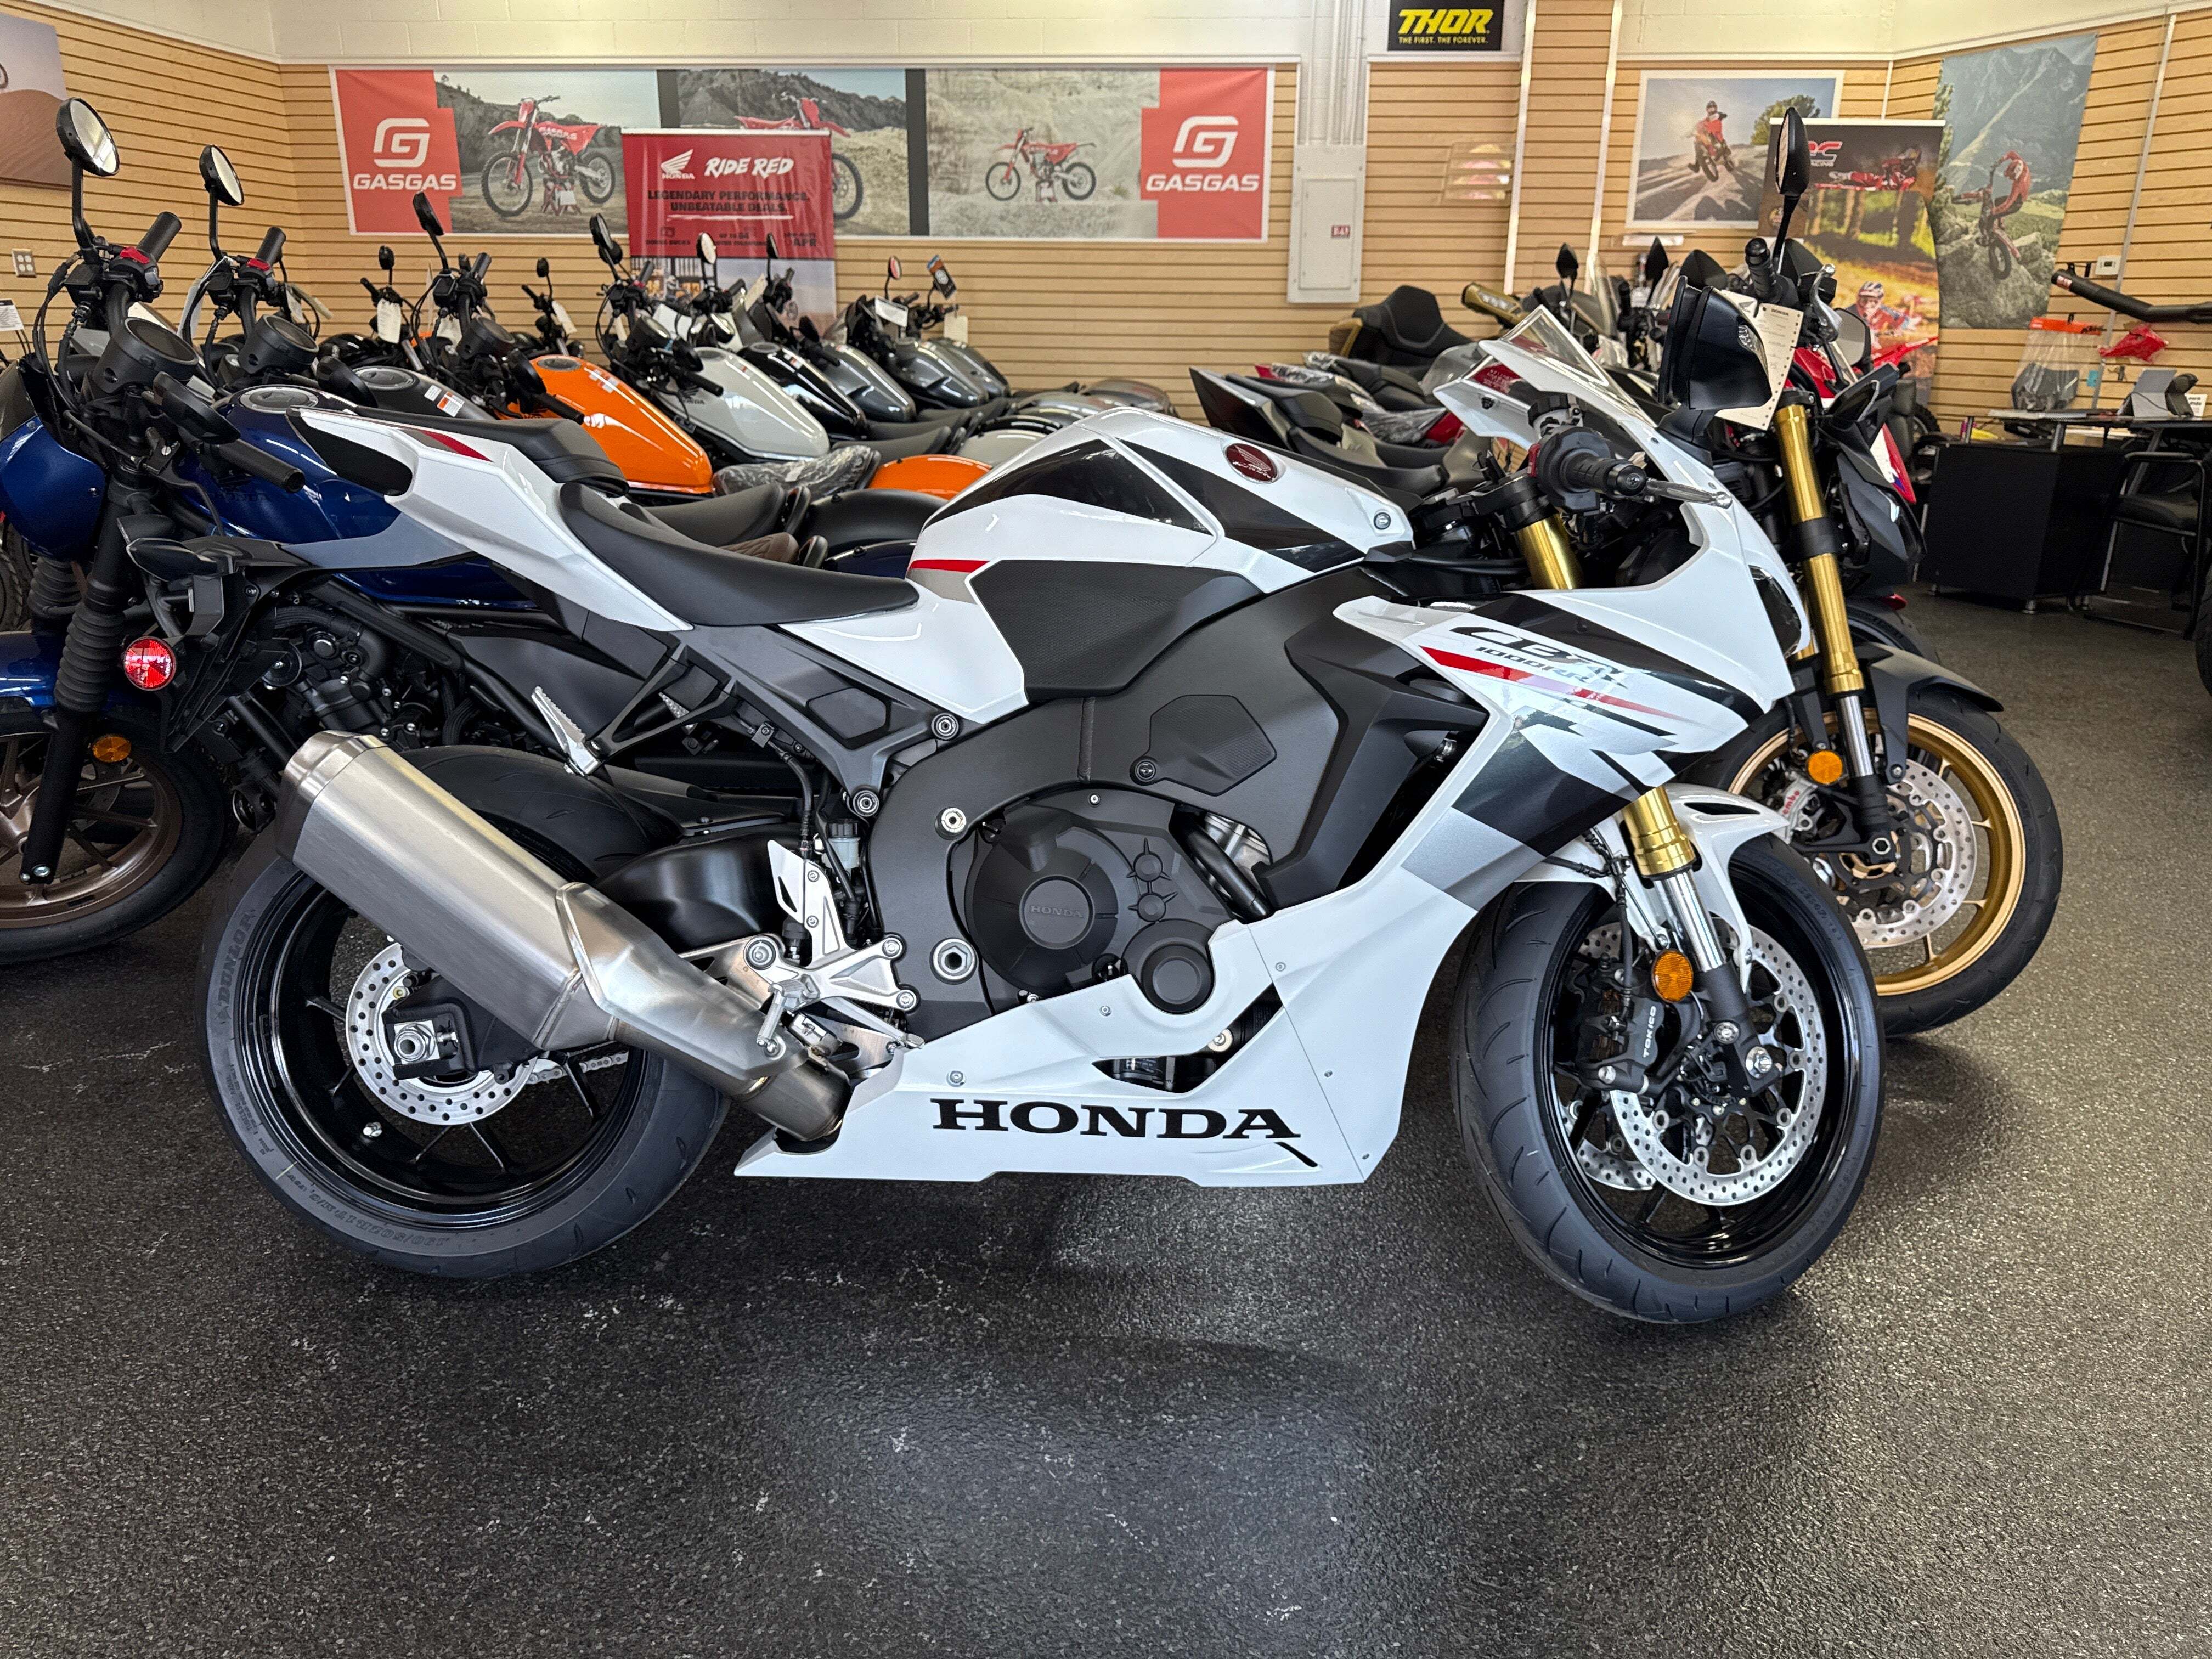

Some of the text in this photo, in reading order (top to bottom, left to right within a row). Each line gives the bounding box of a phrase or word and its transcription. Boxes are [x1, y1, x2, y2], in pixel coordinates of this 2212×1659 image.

[1398, 9, 1494, 34] THOR
[704, 157, 794, 179] RIDE RED
[353, 173, 457, 190] GASGAS
[1146, 174, 1260, 191] GASGAS
[648, 190, 715, 200] LEGENDARY
[671, 202, 744, 212] UNBEATABLE
[1031, 906, 1084, 918] HONDA
[218, 913, 251, 1005] DUNLOP
[1643, 1006, 1656, 1058] TOKICO
[931, 1098, 1301, 1139] HONDA
